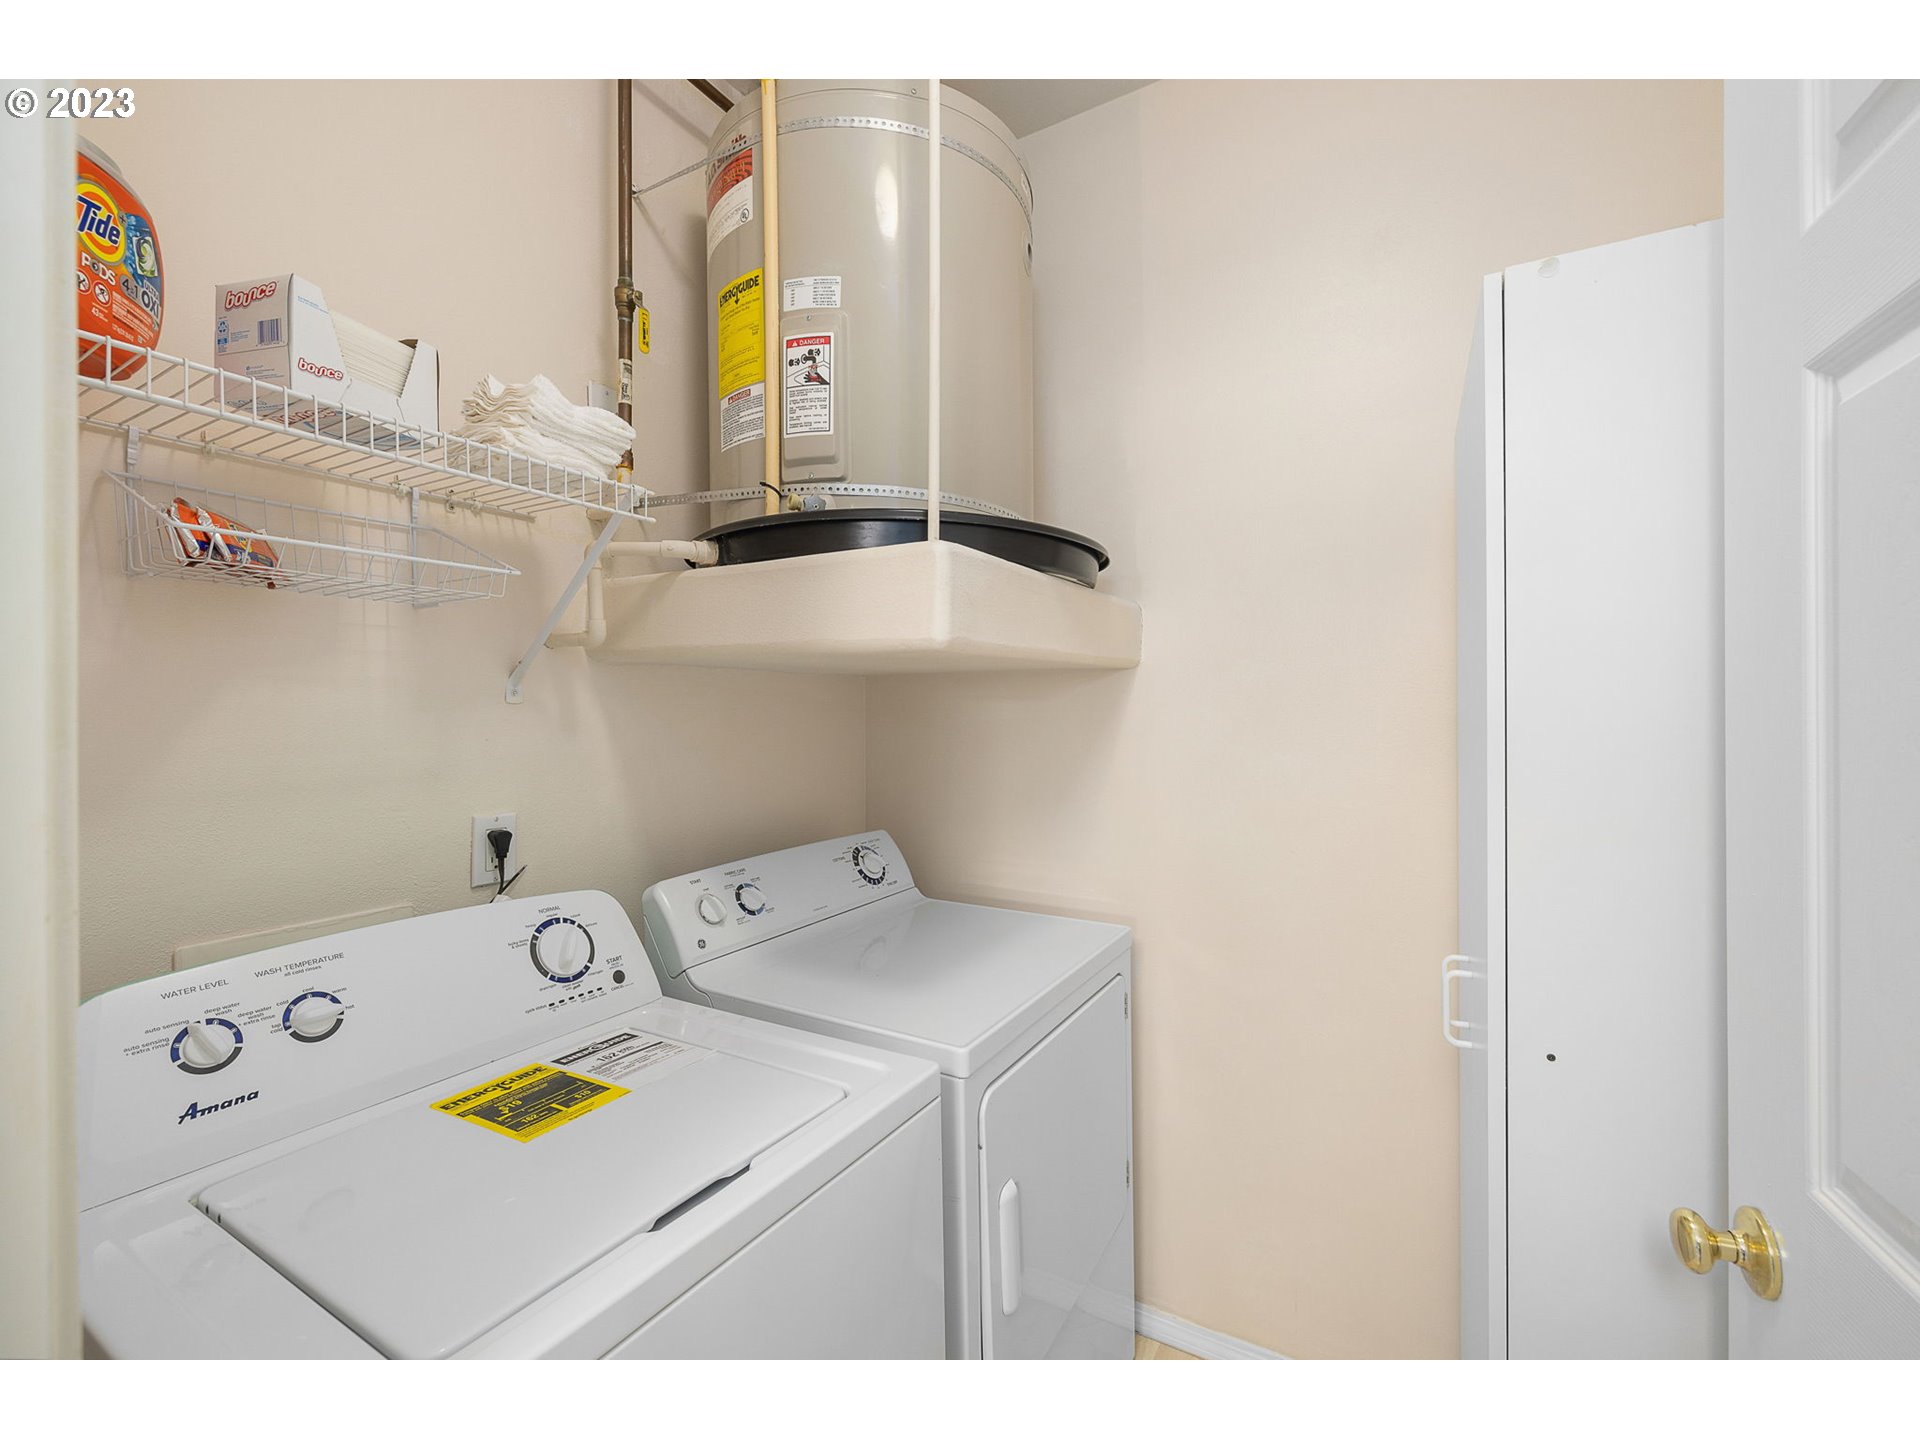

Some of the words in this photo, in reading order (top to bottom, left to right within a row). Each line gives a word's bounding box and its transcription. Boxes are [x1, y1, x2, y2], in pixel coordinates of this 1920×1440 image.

[77, 194, 121, 246] Tide
[81, 252, 116, 285] PODS
[225, 281, 277, 311] bounce
[141, 289, 160, 319] OXI
[800, 338, 825, 346] DANGER
[298, 357, 343, 380] bounce
[538, 905, 561, 914] NORMAL
[254, 966, 282, 978] WASH
[284, 952, 345, 971] TEMPERATURE
[606, 955, 622, 964] START
[160, 985, 197, 1000] WATER
[199, 979, 230, 991] LEVEL
[204, 1006, 221, 1015] deep
[221, 1001, 241, 1010] water
[276, 999, 290, 1007] cold
[215, 1008, 233, 1016] wash
[237, 1009, 254, 1018] deep
[254, 1005, 272, 1014] water
[247, 1012, 264, 1020] wash
[144, 1026, 161, 1034] auto
[162, 1019, 190, 1031] sensing
[243, 1018, 260, 1026] extra
[270, 1027, 283, 1035] cold
[123, 1044, 140, 1053] auto
[141, 1036, 170, 1049] sensing
[131, 1047, 150, 1056] extra
[151, 1041, 170, 1051] rinse
[439, 1065, 548, 1111] ENERGYGUIDE
[177, 1089, 260, 1125] Amana
